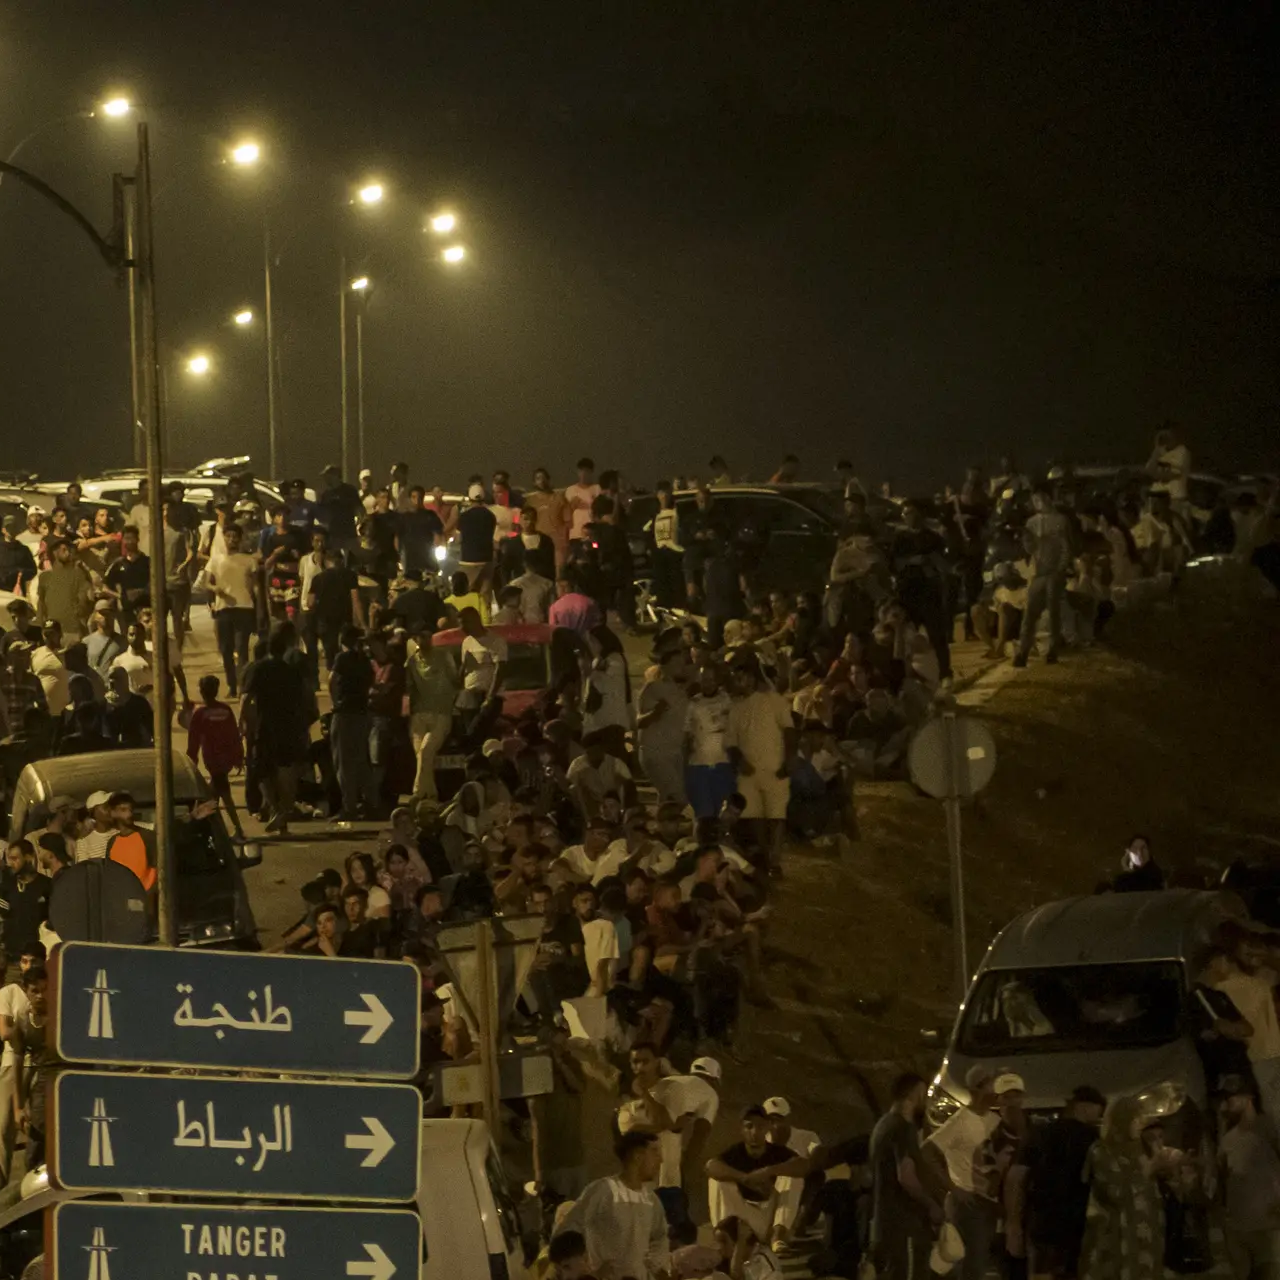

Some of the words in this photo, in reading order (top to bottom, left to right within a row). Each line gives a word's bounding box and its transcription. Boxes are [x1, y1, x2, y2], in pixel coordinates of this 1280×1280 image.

[173, 983, 292, 1040] طنجة
[173, 1100, 292, 1171] الرباط
[181, 1224, 286, 1257] TANGER
